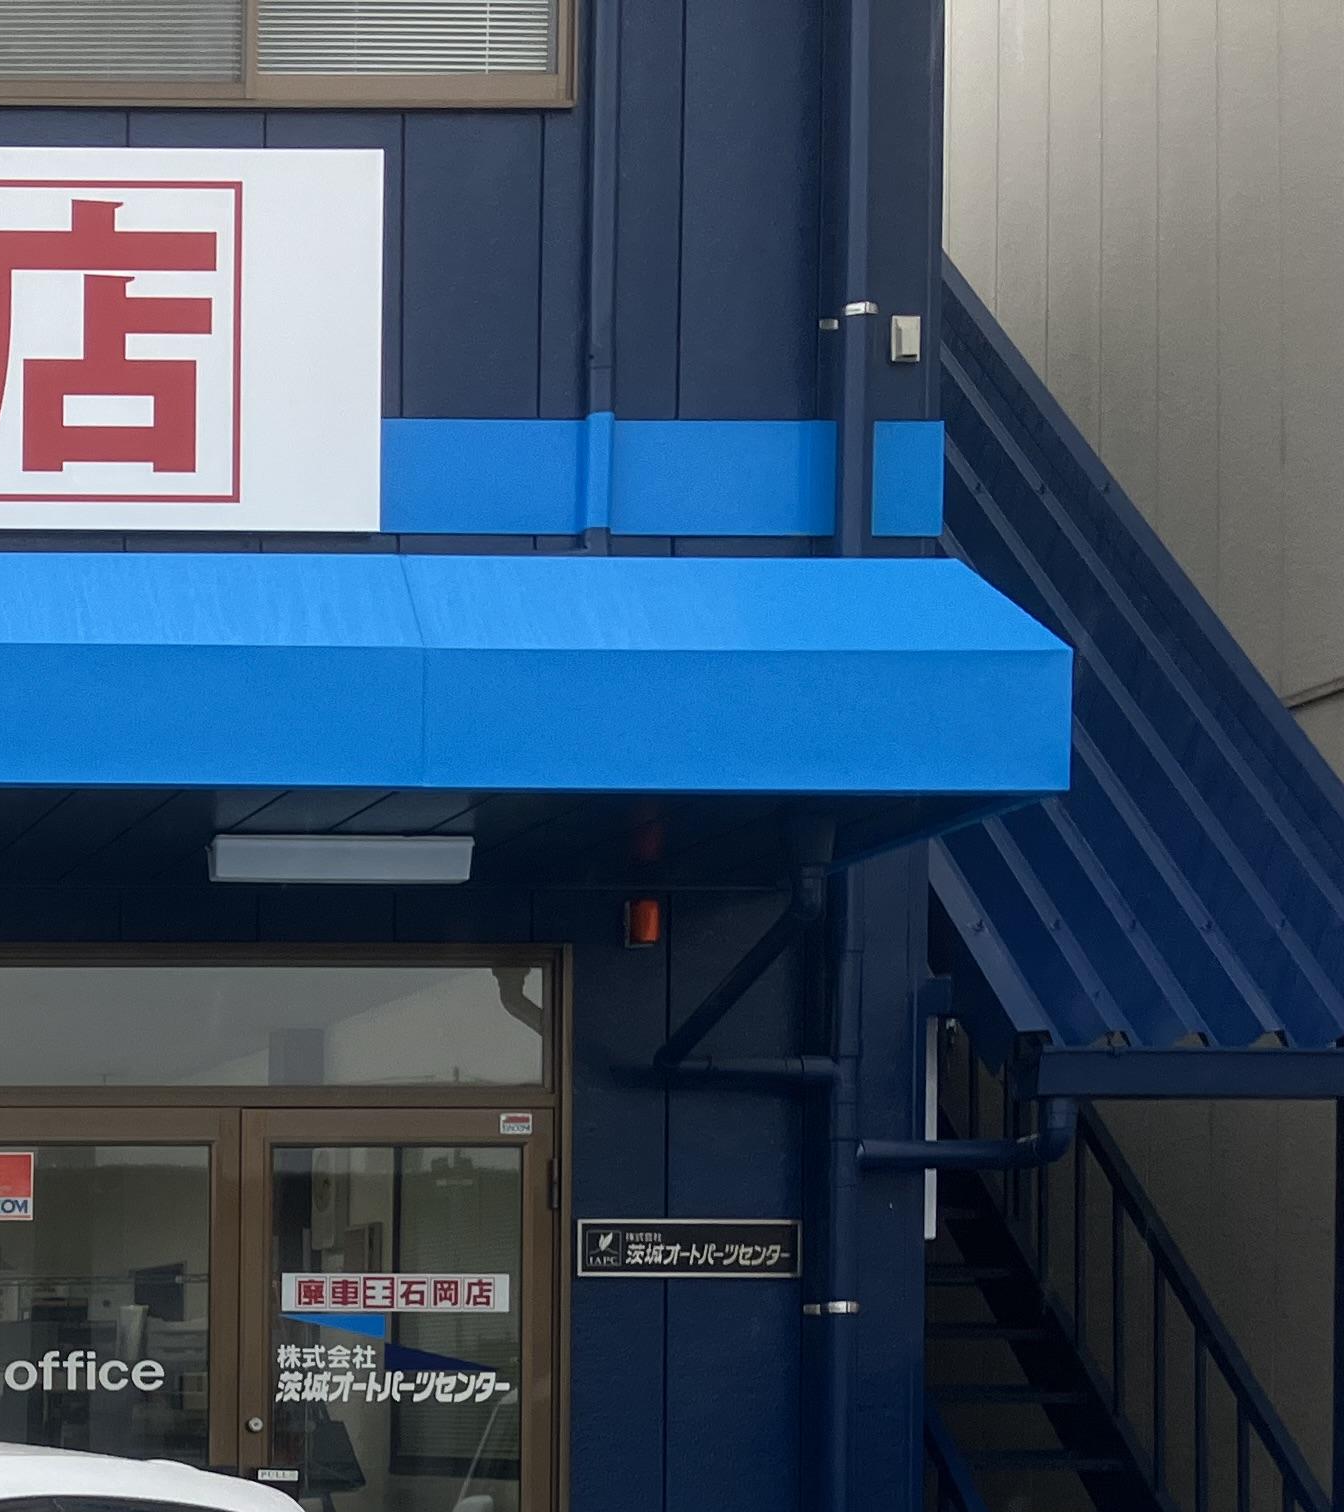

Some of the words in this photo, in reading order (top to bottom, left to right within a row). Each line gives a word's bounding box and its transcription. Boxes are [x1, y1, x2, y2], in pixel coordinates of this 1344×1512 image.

[4, 1350, 165, 1391] office
[276, 1344, 376, 1369] 株式会社
[275, 1371, 511, 1403] 茨城オートパーツセンター
